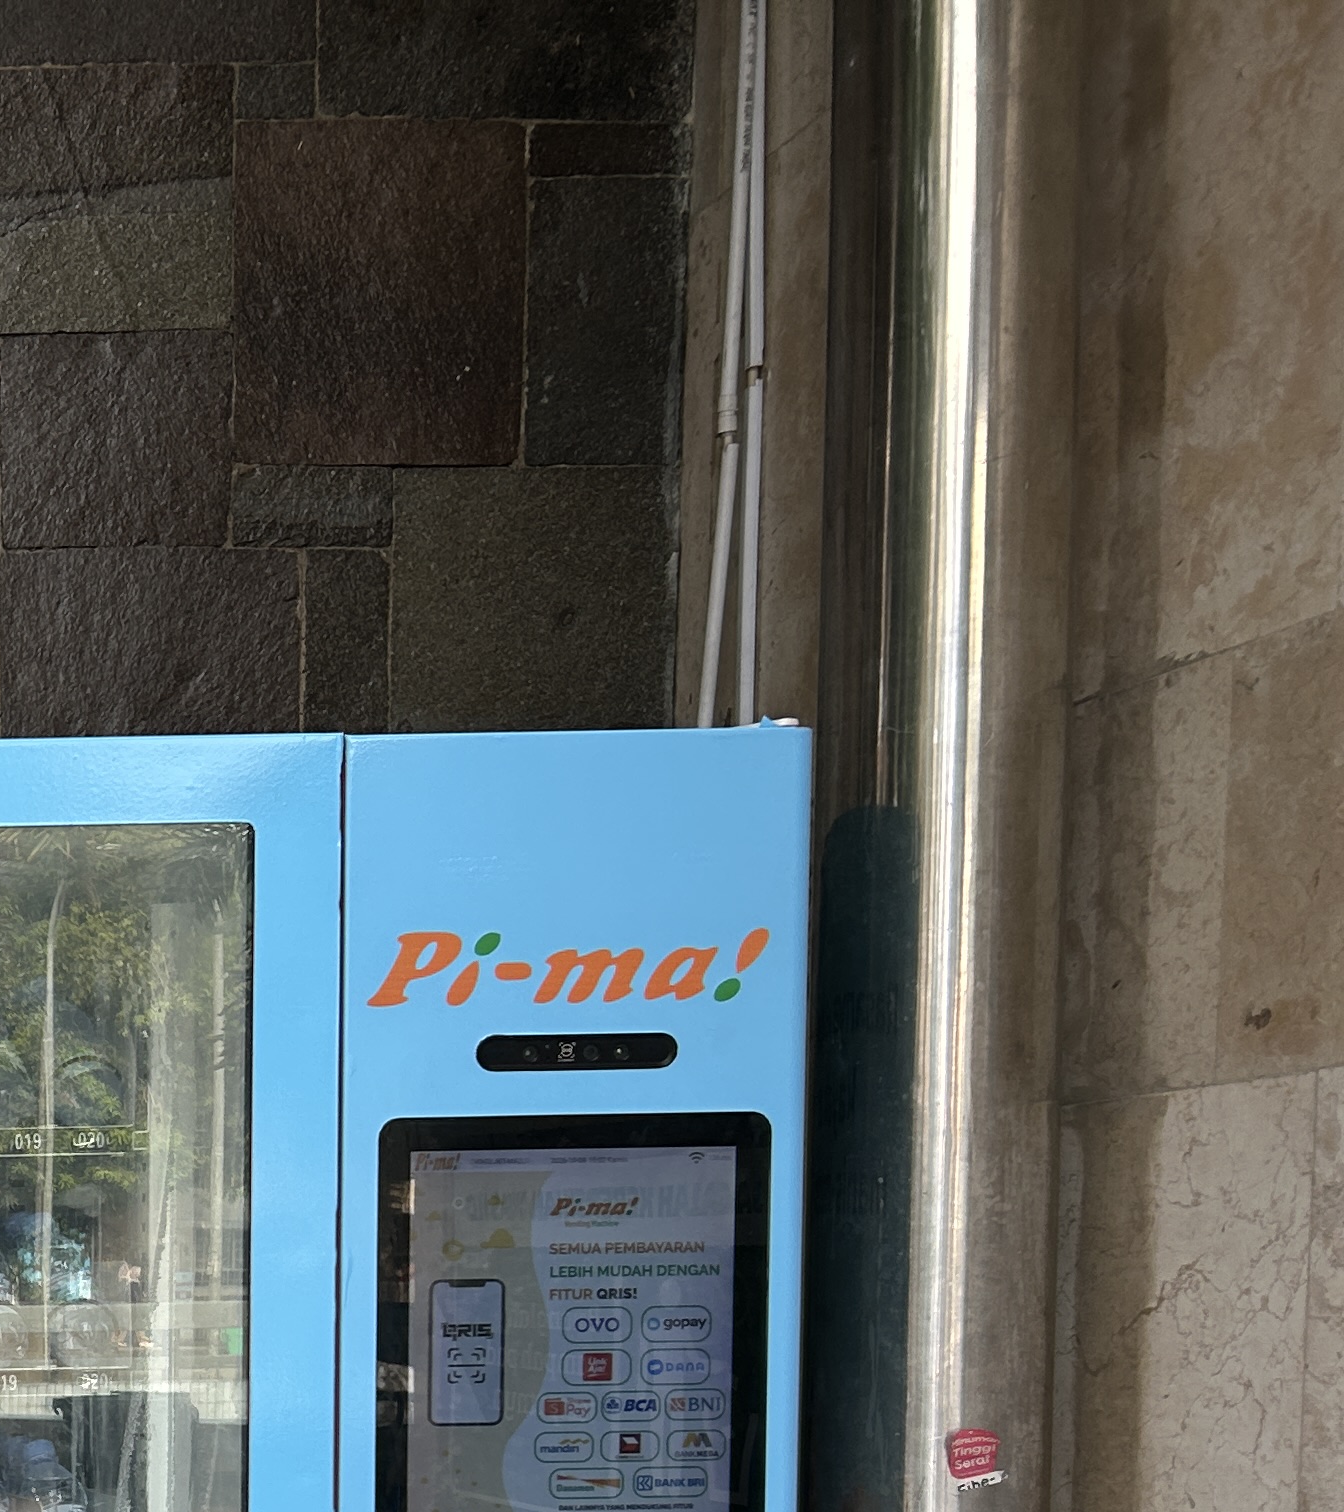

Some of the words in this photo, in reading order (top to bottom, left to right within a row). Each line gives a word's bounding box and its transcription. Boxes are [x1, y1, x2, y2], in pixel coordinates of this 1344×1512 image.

[366, 927, 770, 1008] Pi-ma!
[14, 1133, 42, 1151] 019
[548, 1196, 639, 1217] Pi-ma!
[549, 1242, 602, 1255] SEMUA
[605, 1241, 705, 1254] PEMBAYARAN
[549, 1265, 593, 1278] LEBIH
[597, 1265, 653, 1278] MUDAH
[656, 1263, 721, 1277] DENGAN
[549, 1288, 593, 1301] FITUR
[596, 1287, 638, 1301] QRIS!
[574, 1317, 620, 1333] OVO
[663, 1317, 707, 1331] gopay
[623, 1398, 658, 1412] BCA
[687, 1397, 721, 1412] BNI
[954, 1455, 991, 1470] Serat
[654, 1477, 686, 1488] BANK
